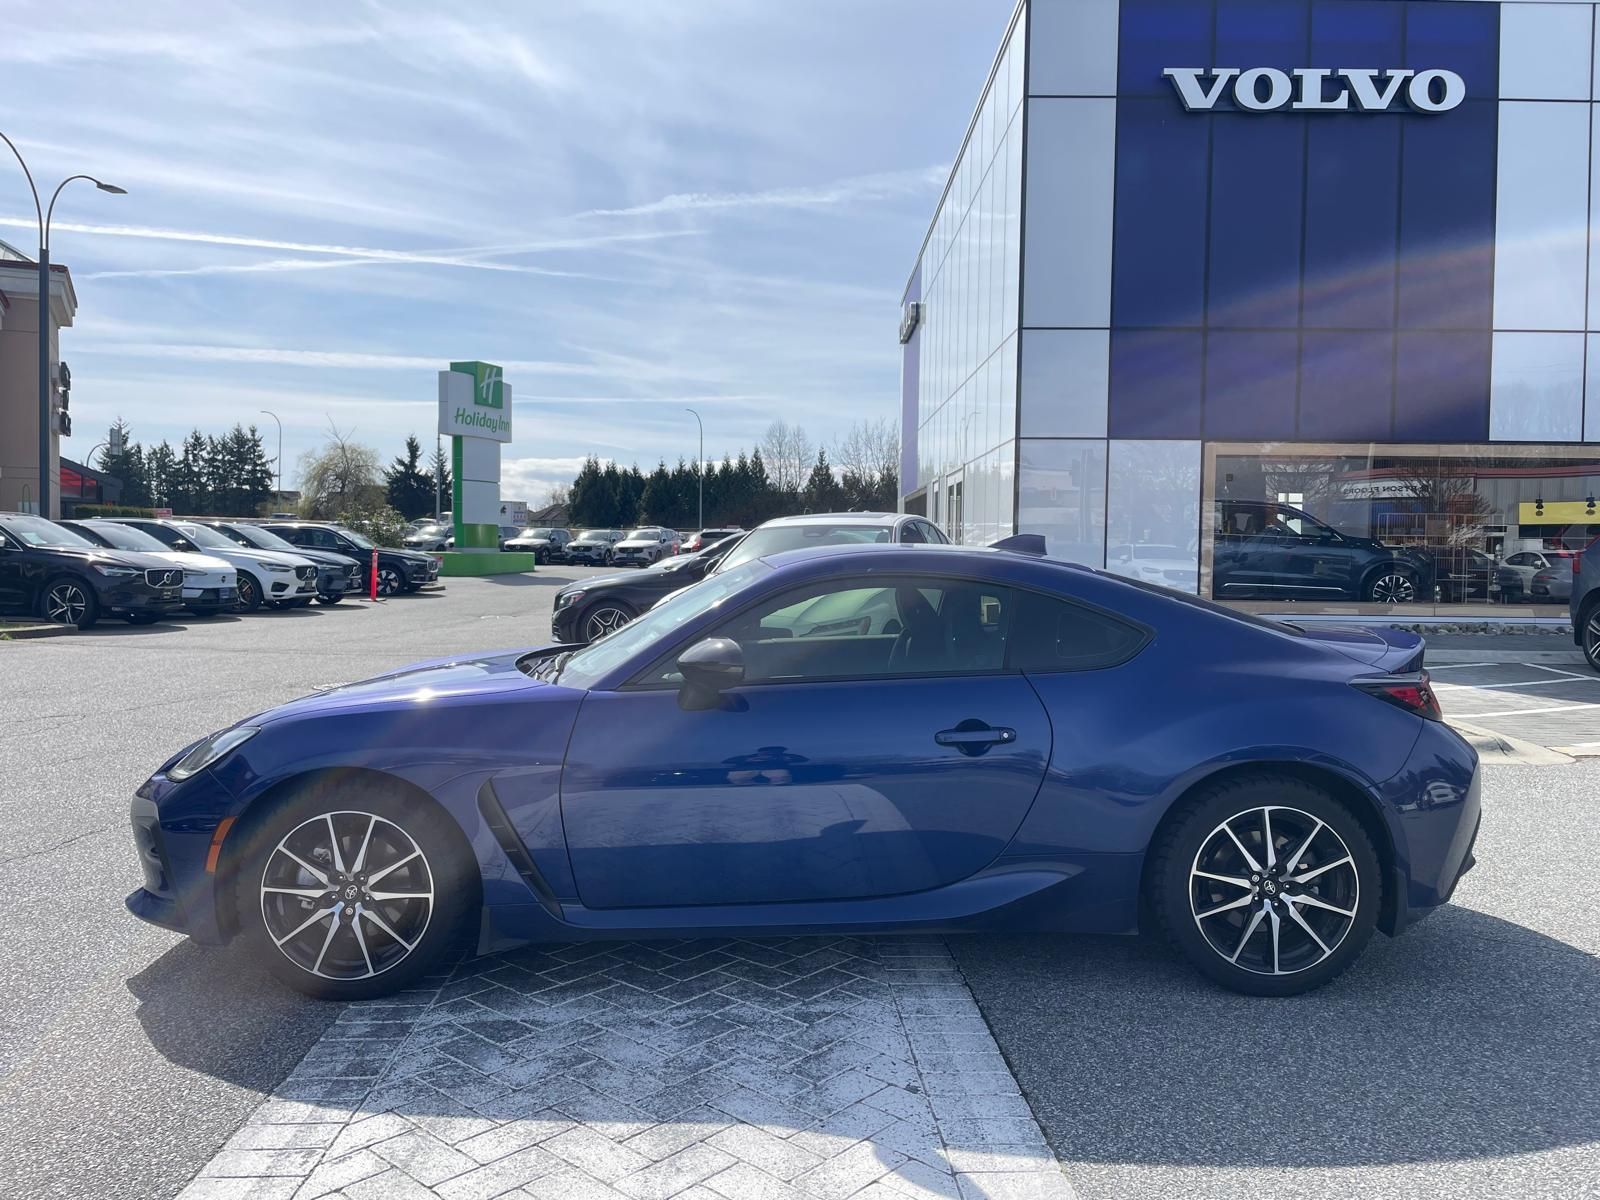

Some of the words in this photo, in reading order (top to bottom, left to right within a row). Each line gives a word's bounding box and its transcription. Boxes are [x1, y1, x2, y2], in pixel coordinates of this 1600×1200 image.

[1163, 67, 1466, 111] VOLVO
[454, 407, 498, 433] Holiday
[498, 415, 510, 432] Inn
